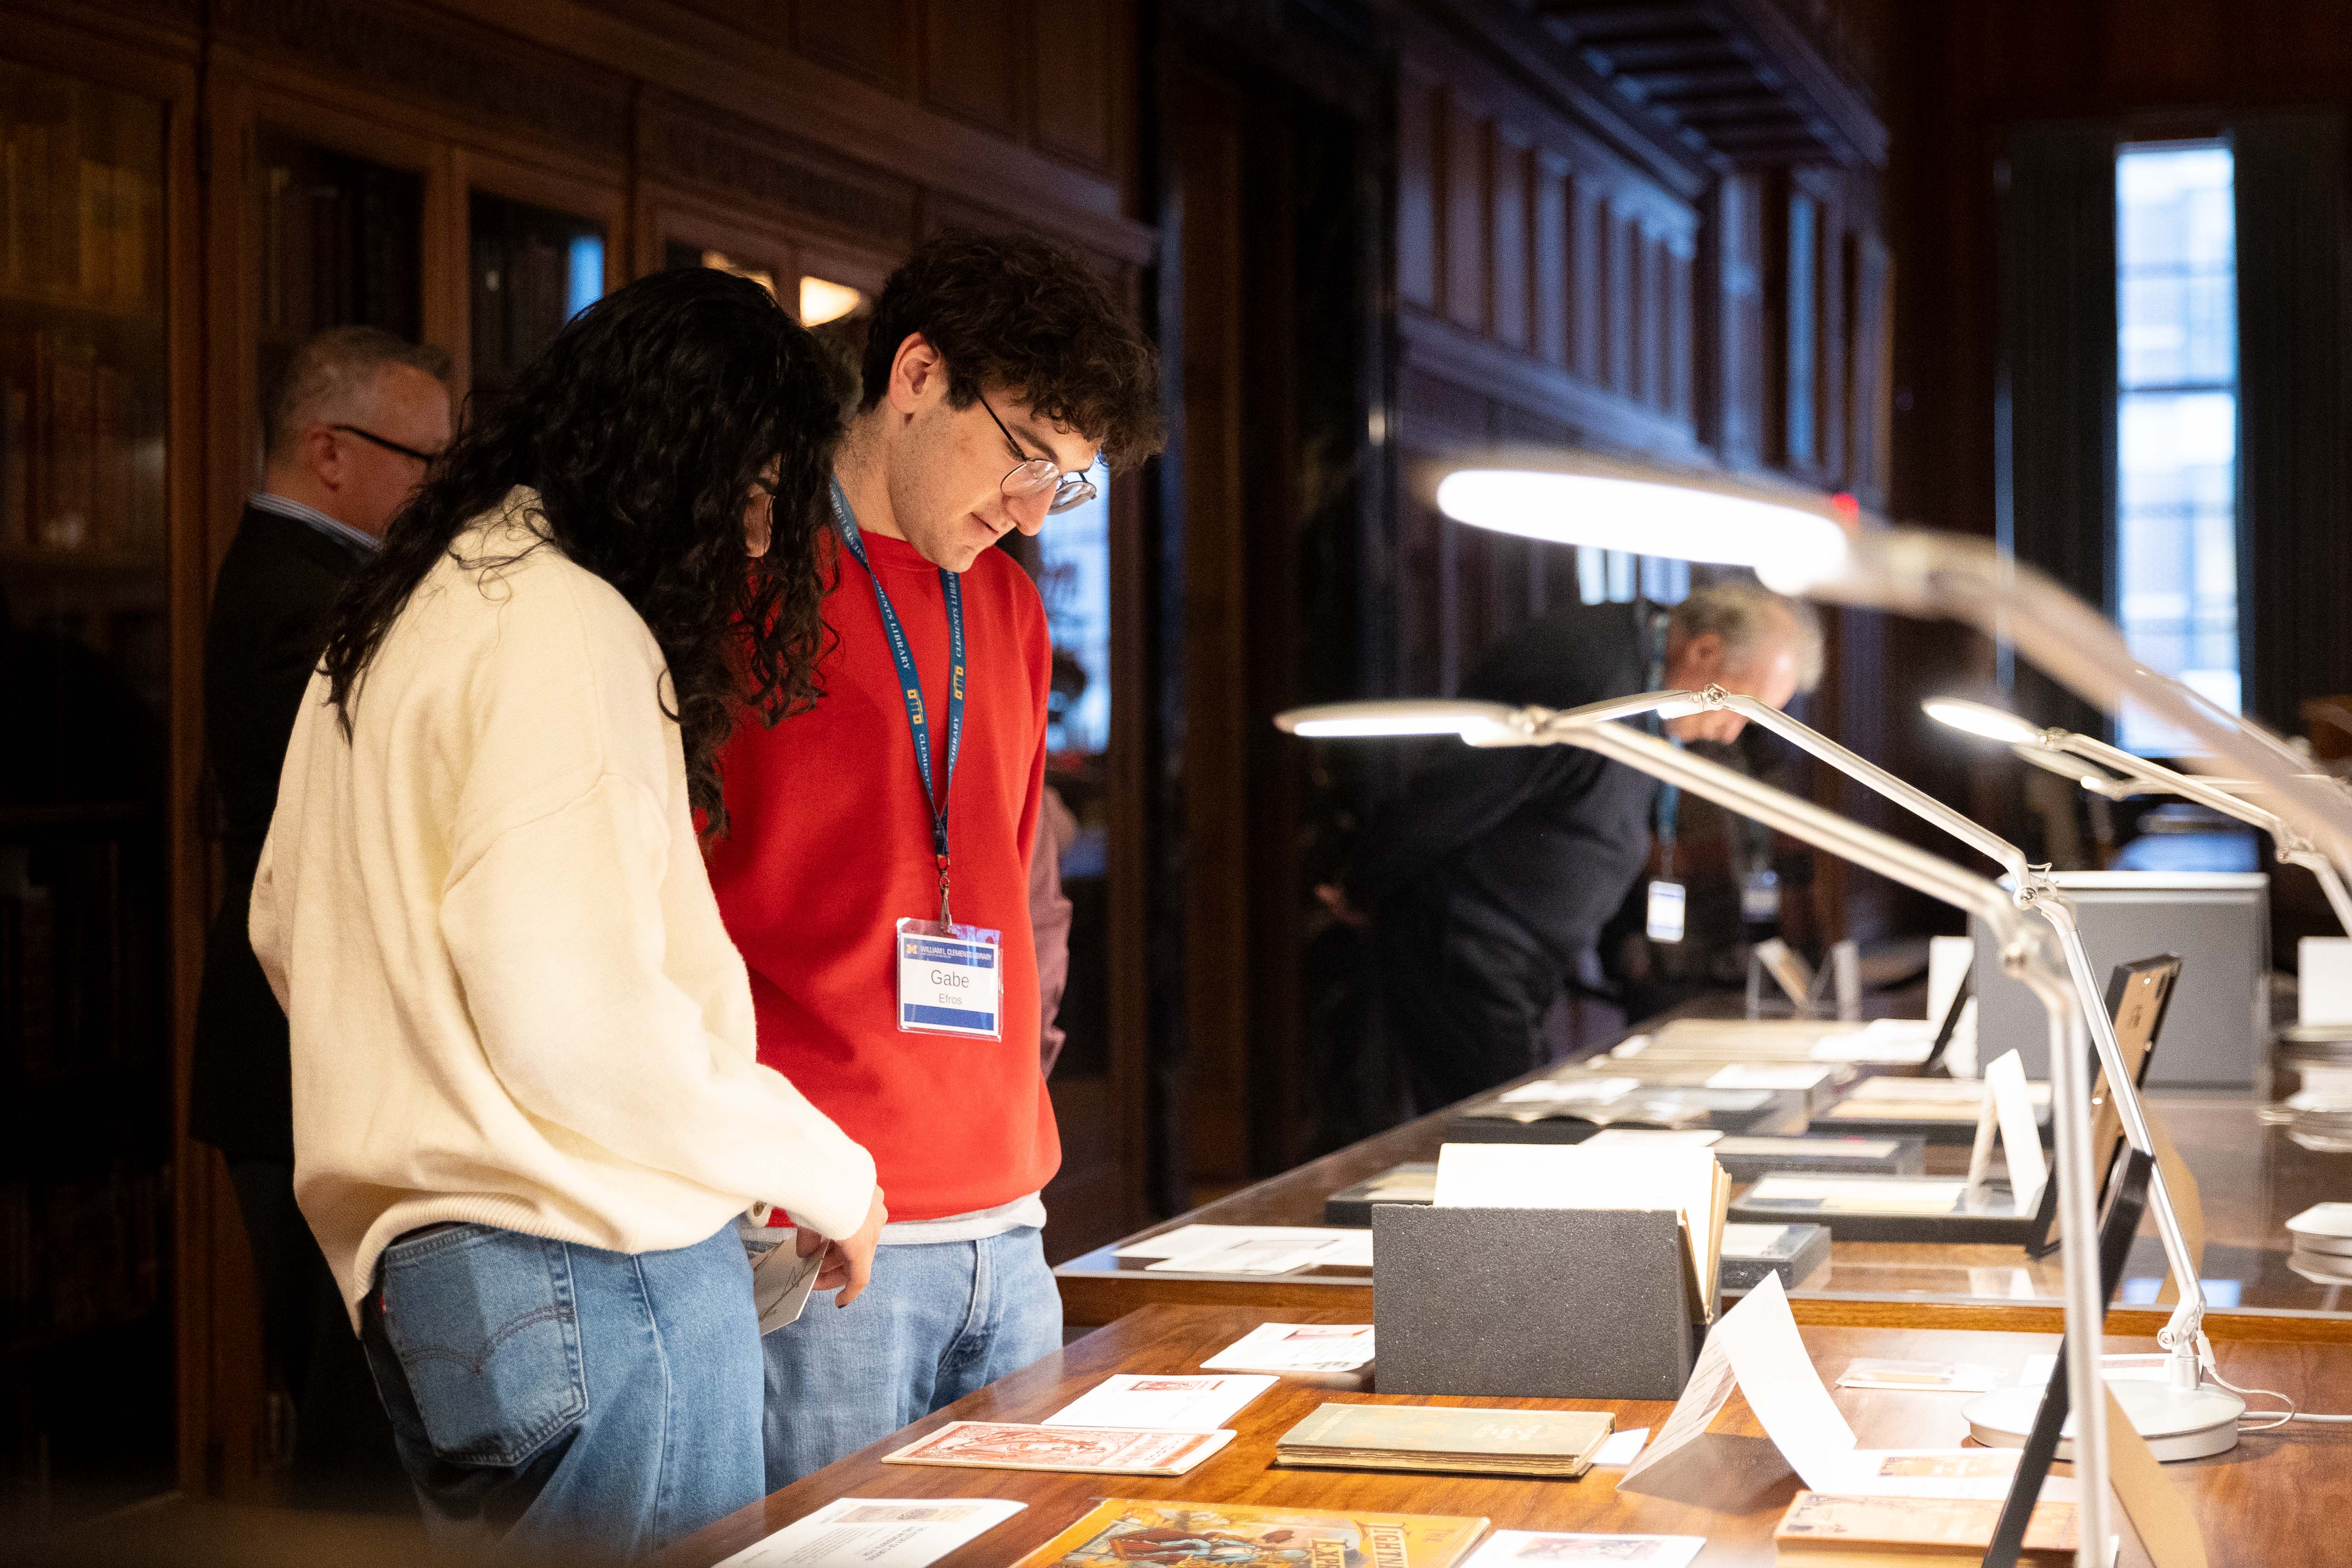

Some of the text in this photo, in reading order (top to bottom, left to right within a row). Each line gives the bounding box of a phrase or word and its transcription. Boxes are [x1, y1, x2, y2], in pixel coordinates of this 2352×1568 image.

[952, 607, 962, 658] CLEMENTS
[890, 622, 911, 670] LIBRARY
[906, 944, 918, 954] M
[947, 948, 972, 959] CLEMENTS
[931, 970, 969, 988] Gabe
[939, 993, 963, 1005] Efros
